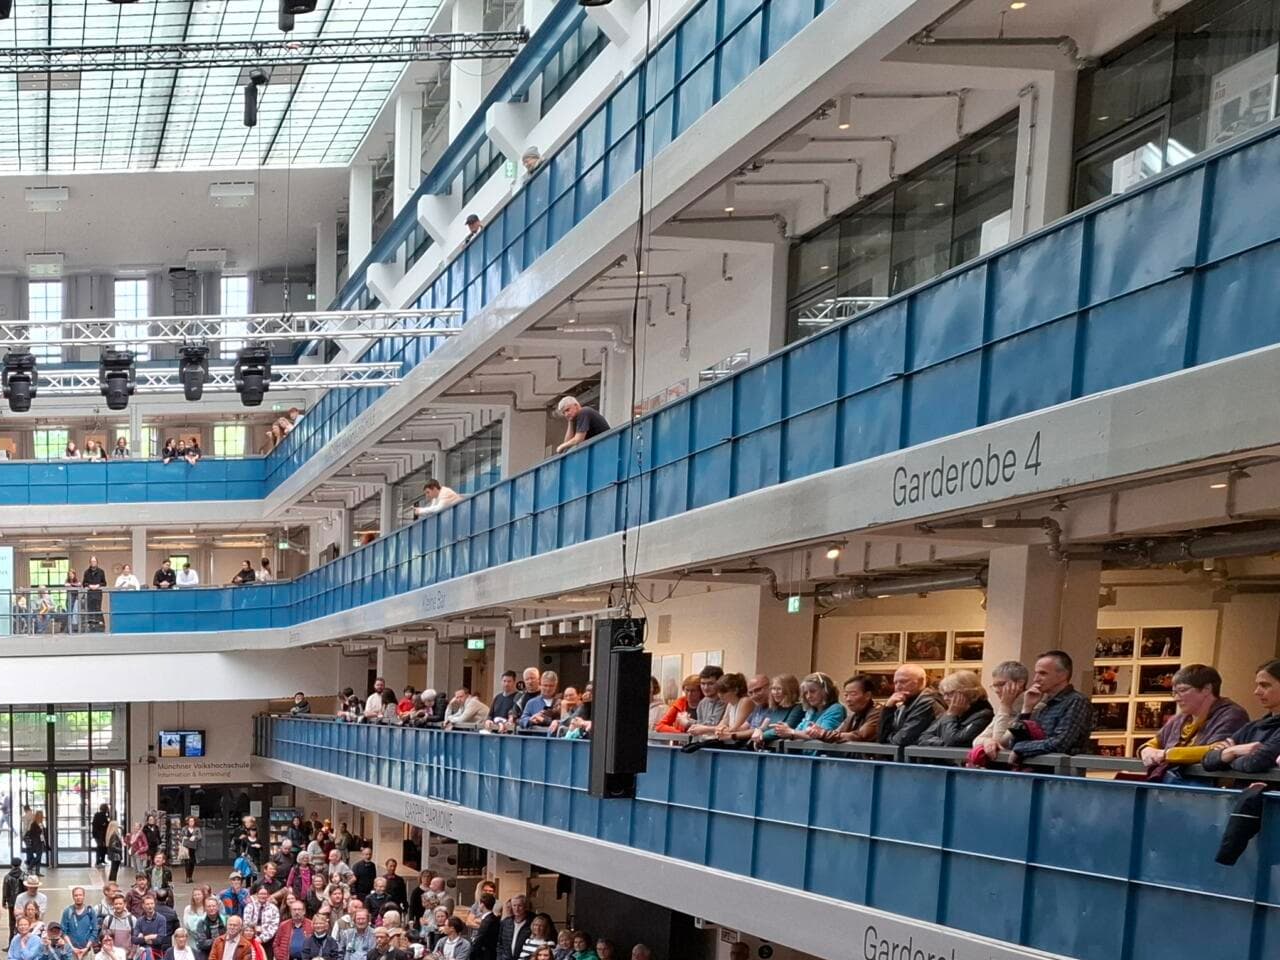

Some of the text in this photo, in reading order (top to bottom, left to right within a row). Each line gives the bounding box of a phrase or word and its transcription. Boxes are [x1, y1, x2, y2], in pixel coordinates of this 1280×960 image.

[893, 431, 1042, 507] Garderobe 4
[194, 760, 250, 769] Volkshochschule
